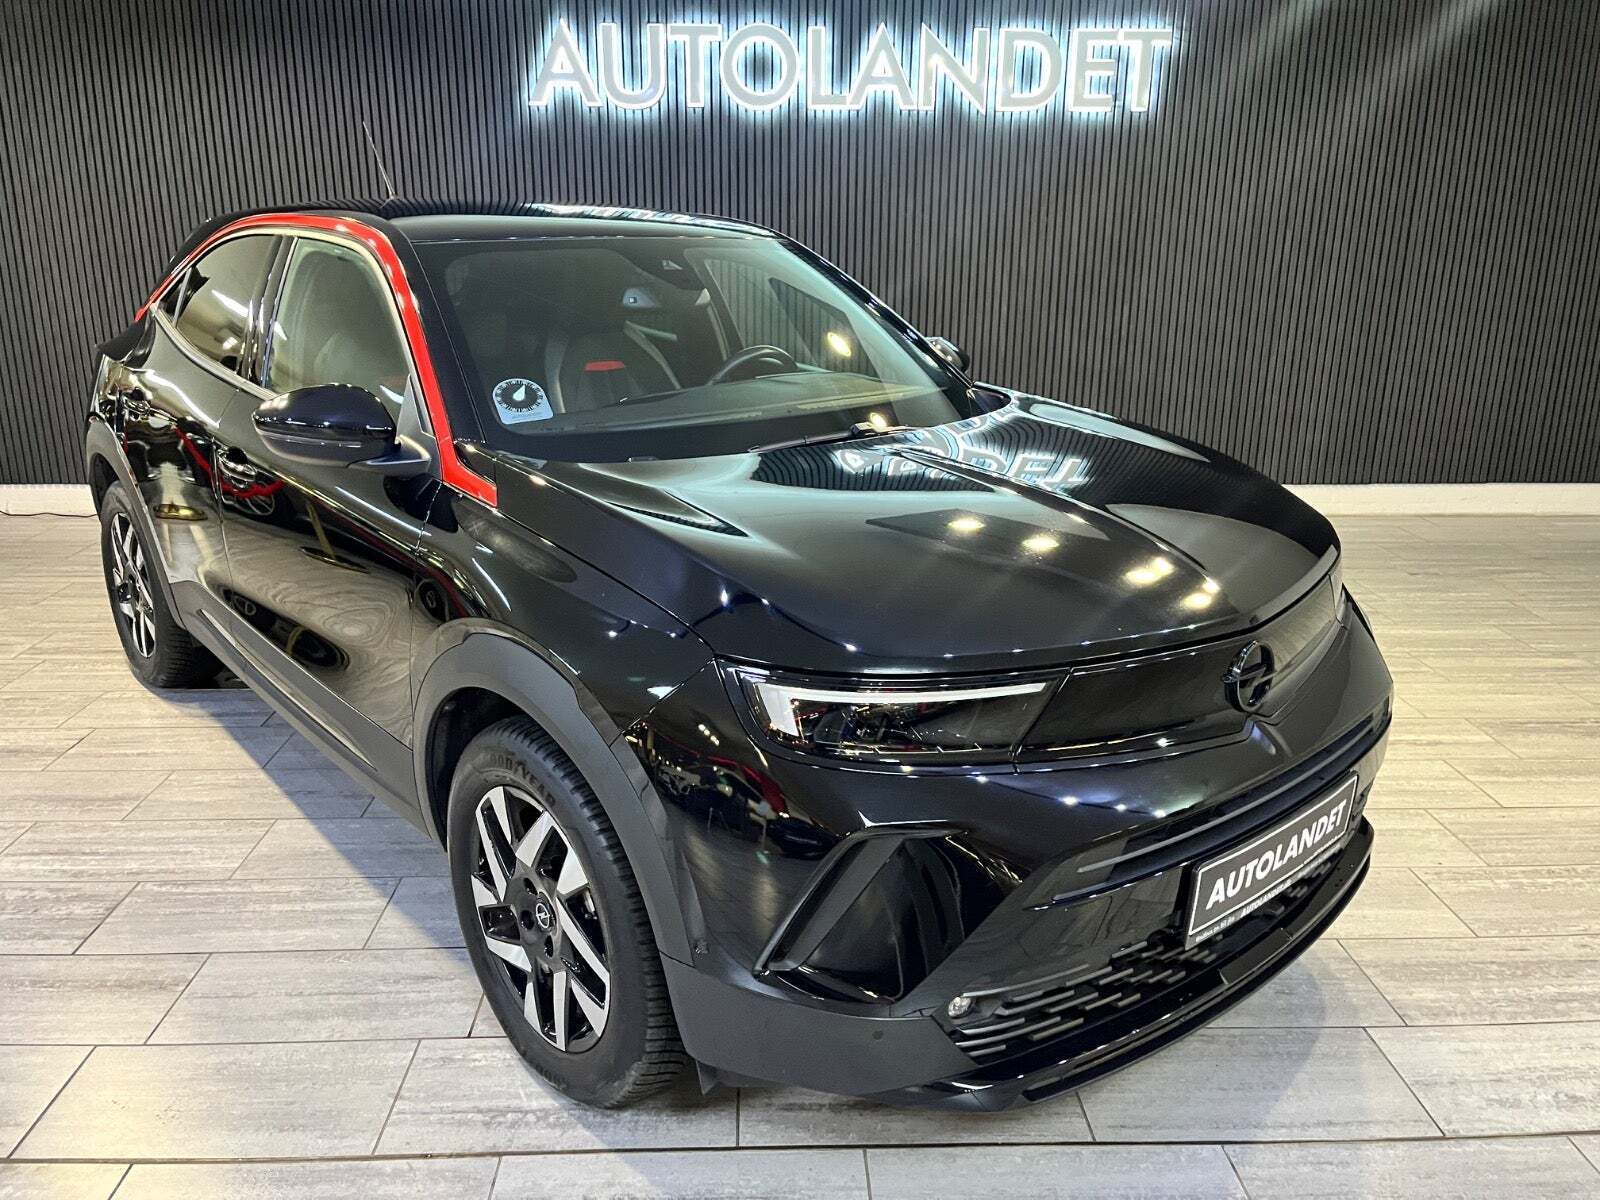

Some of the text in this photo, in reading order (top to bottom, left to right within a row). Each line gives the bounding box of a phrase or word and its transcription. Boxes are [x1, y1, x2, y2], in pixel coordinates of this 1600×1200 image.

[529, 19, 1173, 115] AUTOLANDET
[482, 751, 556, 808] OODYEAR
[1205, 799, 1347, 910] AUTOLANDET
